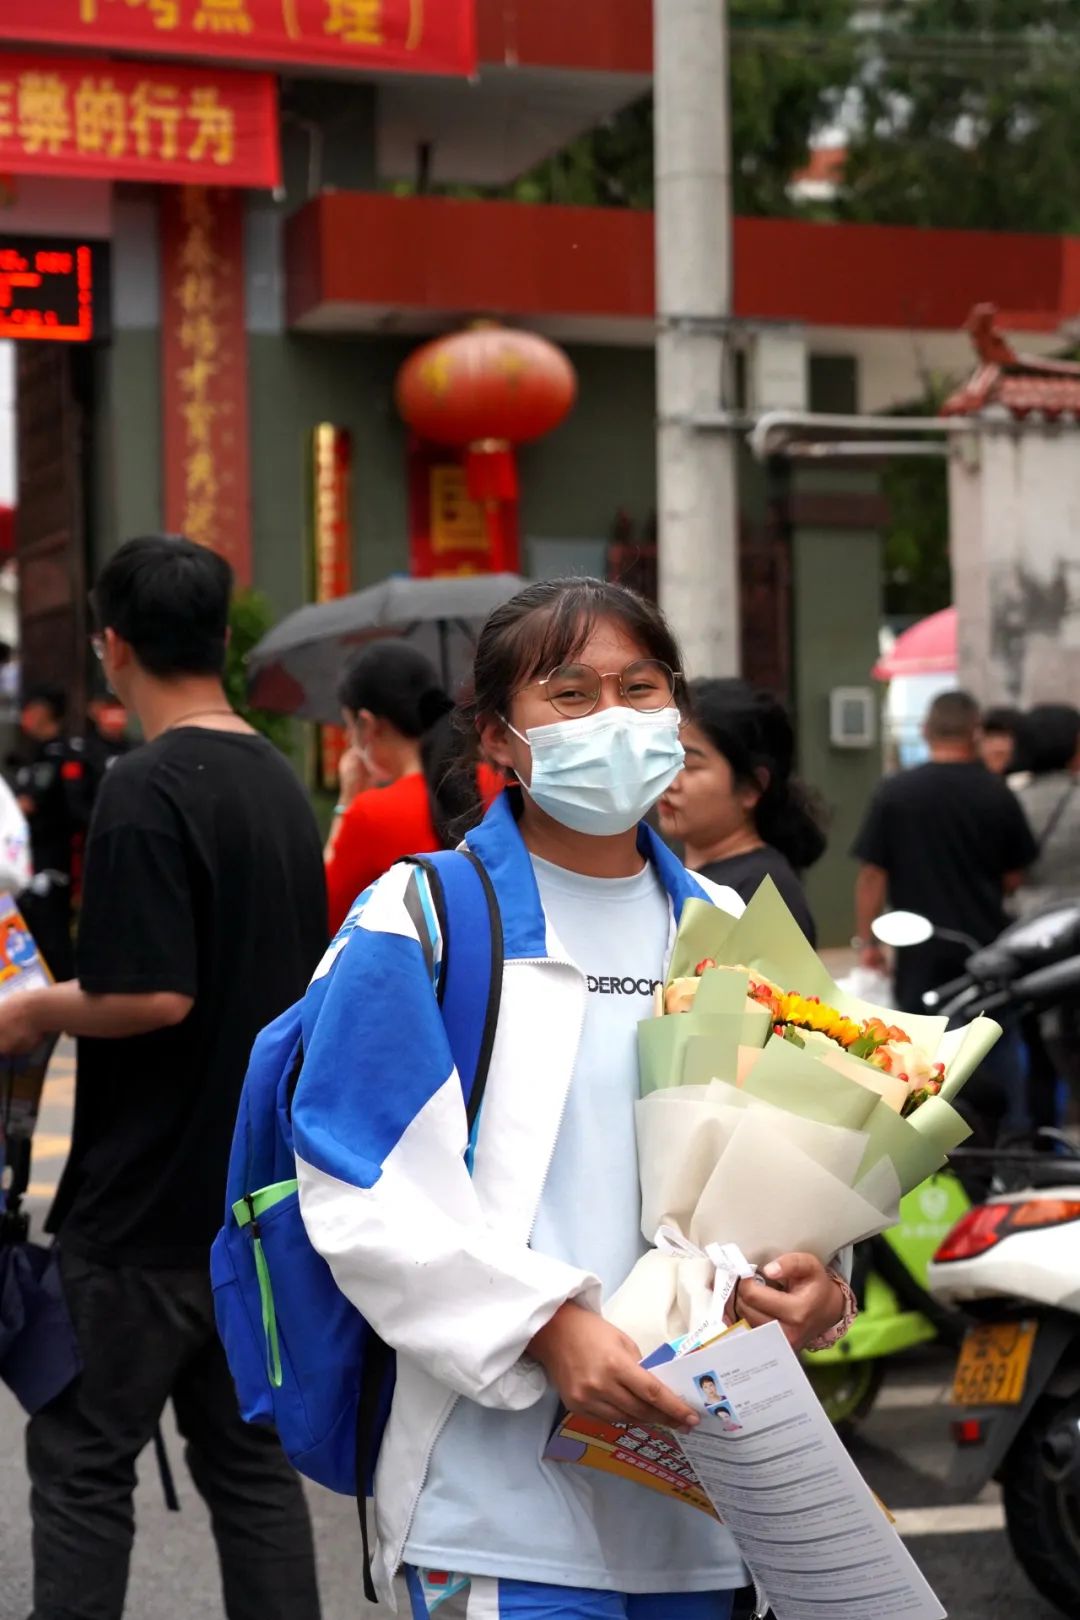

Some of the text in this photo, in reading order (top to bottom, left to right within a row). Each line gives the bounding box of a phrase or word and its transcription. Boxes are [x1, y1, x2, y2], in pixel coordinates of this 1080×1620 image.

[0, 70, 236, 165] 弊的行为
[586, 975, 664, 996] DEROCK
